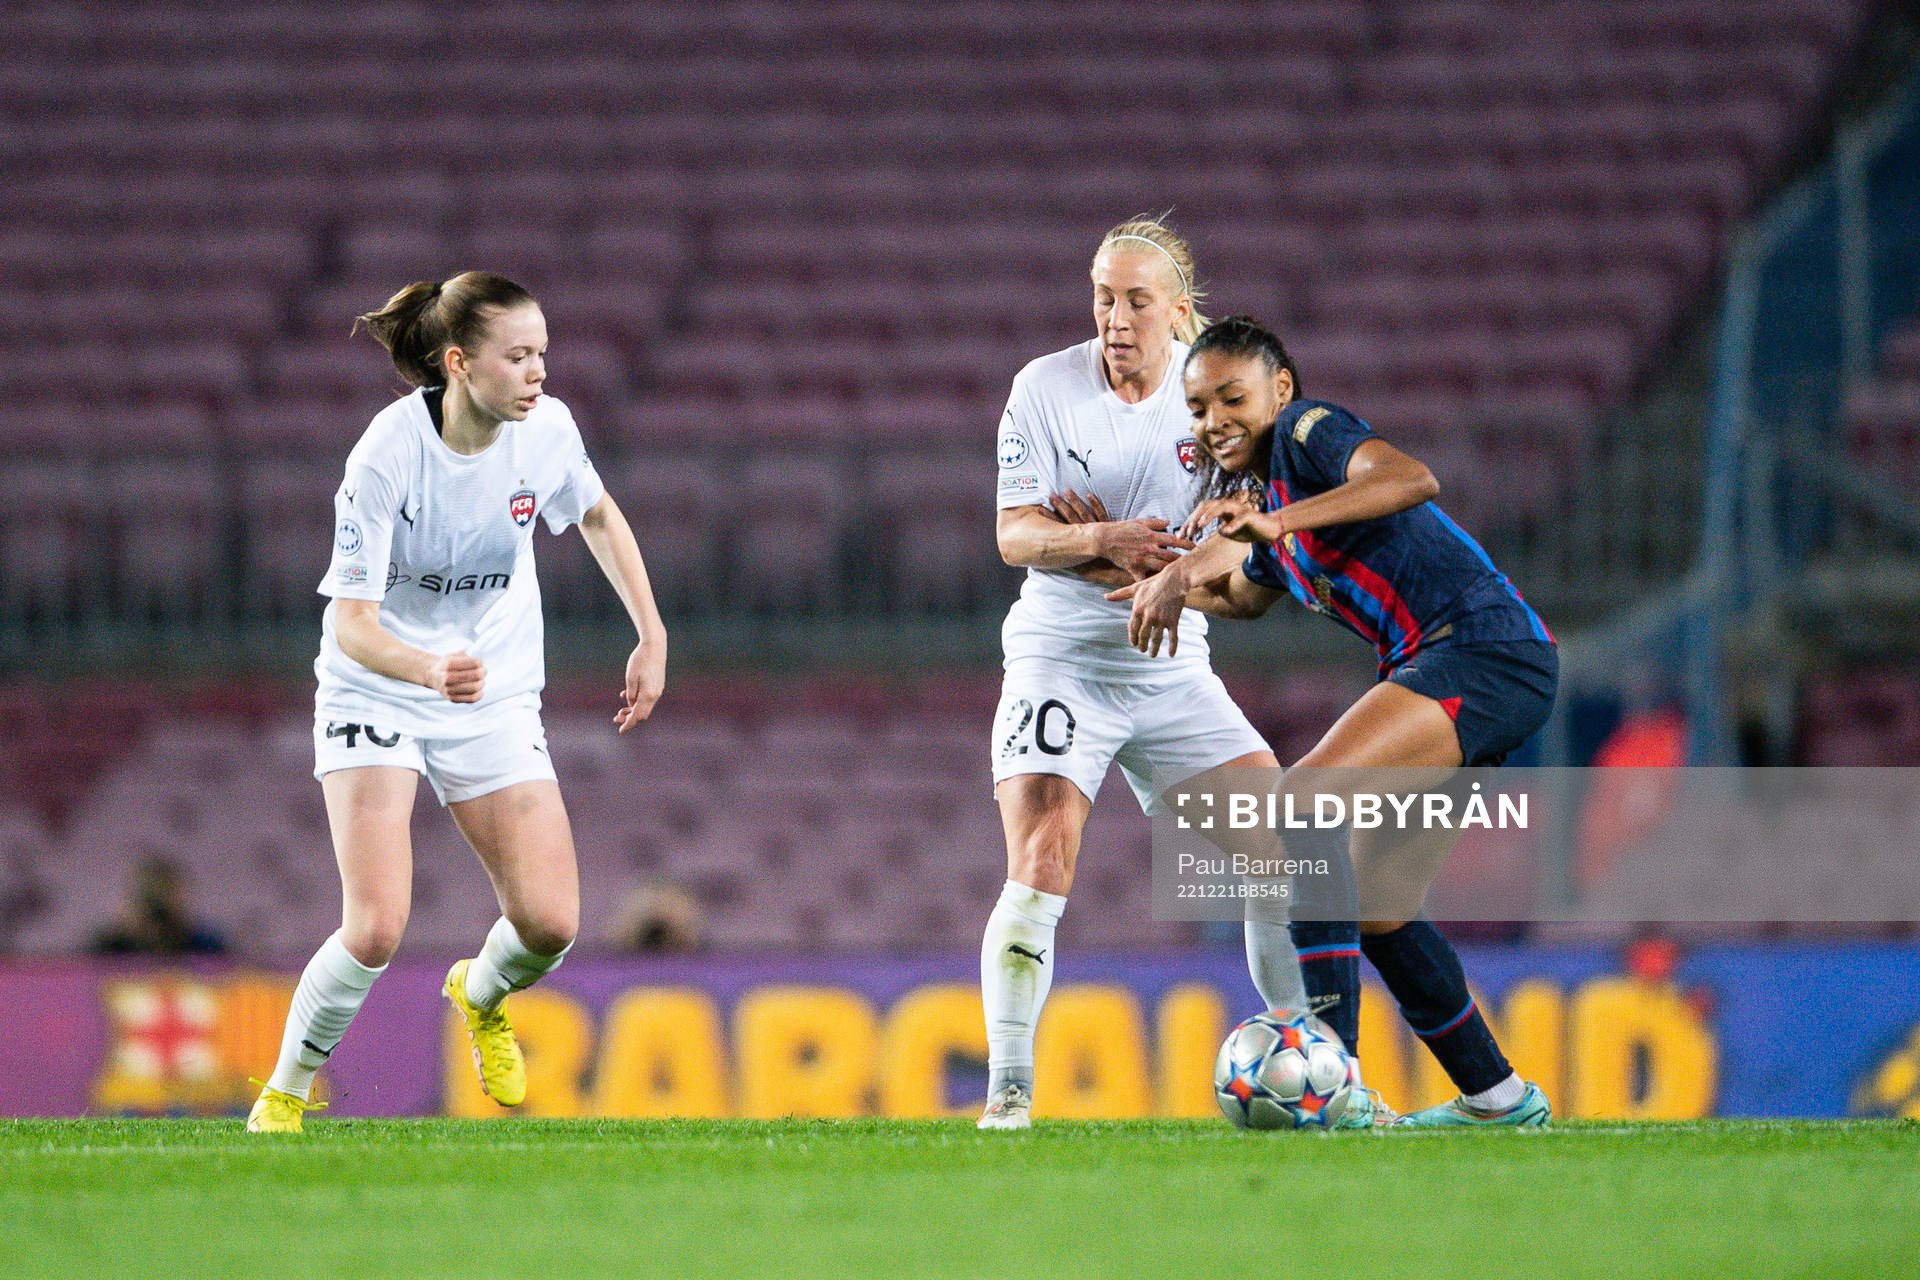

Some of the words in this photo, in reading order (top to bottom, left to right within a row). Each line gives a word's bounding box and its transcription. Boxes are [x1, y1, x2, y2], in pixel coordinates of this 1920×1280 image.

[511, 497, 533, 511] FCR
[419, 573, 511, 595] SIGM
[1001, 698, 1076, 756] 20
